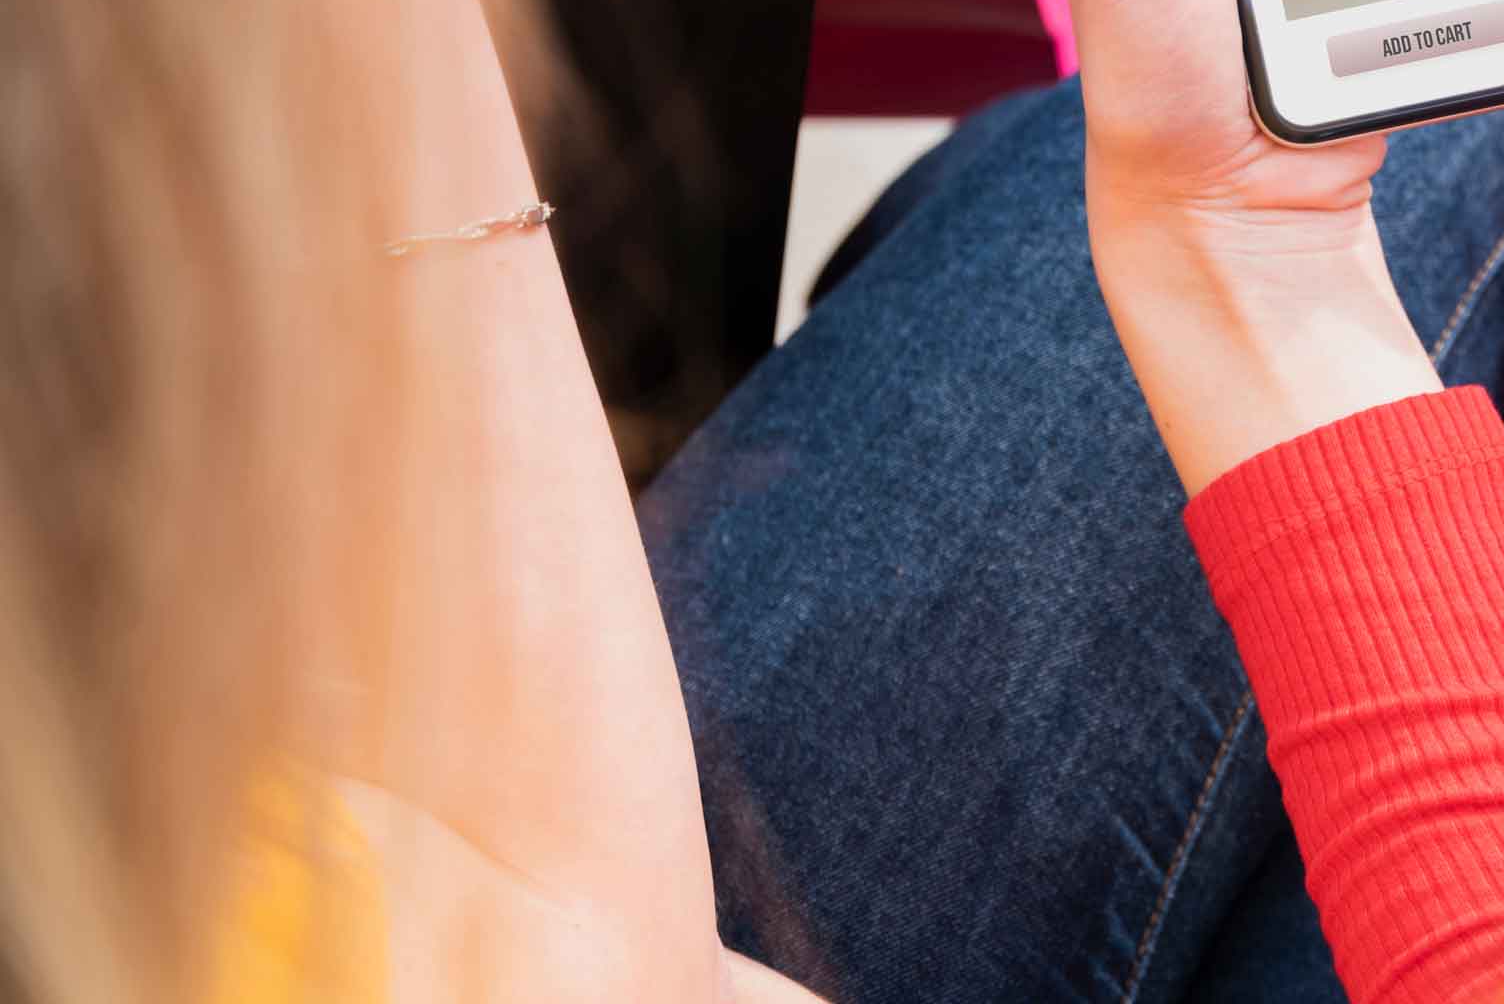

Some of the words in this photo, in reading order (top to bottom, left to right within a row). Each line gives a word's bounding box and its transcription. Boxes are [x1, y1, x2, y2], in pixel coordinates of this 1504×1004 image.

[1382, 34, 1412, 58] ADD
[1413, 29, 1433, 51] TO
[1435, 21, 1473, 47] CART
